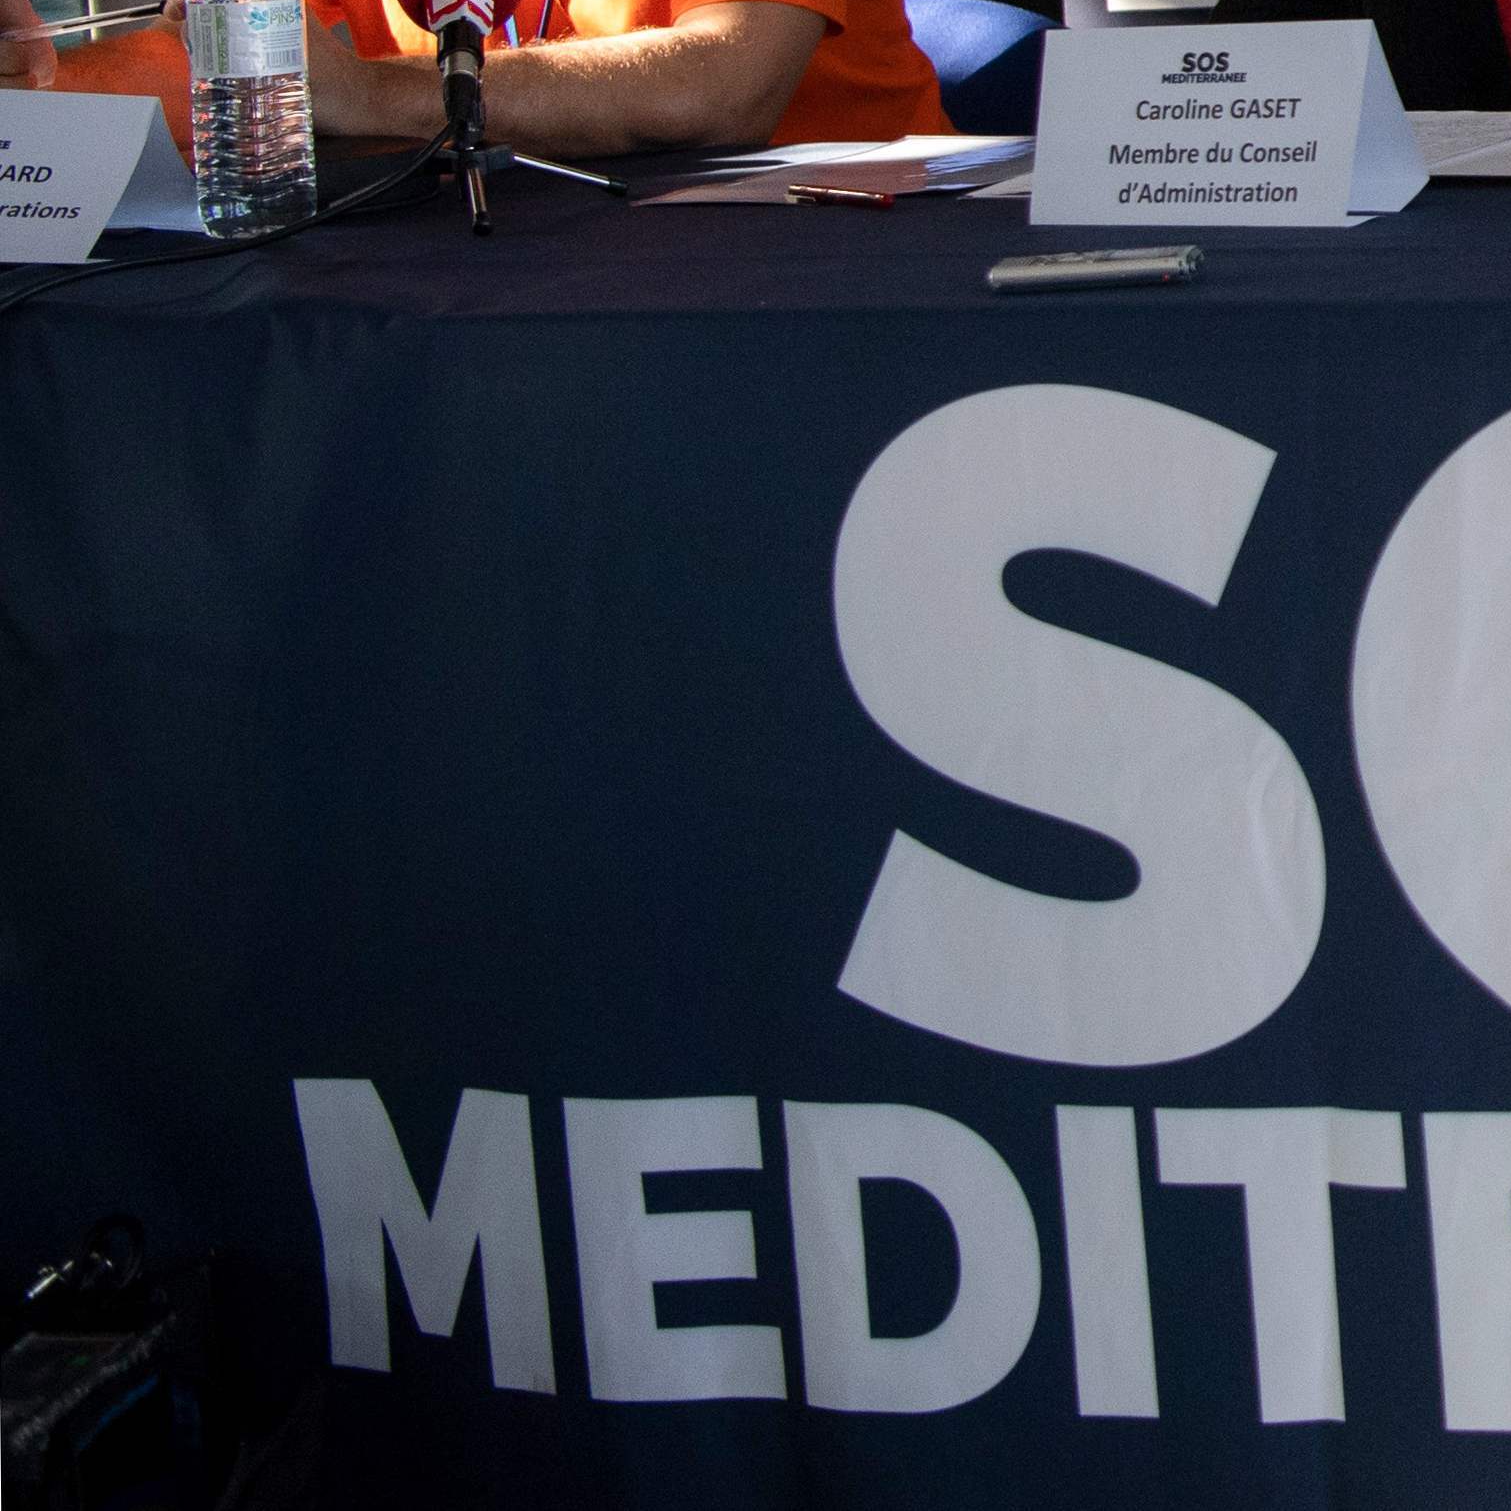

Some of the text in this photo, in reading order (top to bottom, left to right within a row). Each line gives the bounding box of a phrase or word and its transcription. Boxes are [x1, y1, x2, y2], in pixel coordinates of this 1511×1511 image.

[1182, 52, 1230, 73] SOS
[1161, 72, 1248, 85] MEDITERRANEE
[1136, 98, 1301, 121] Caroline GASET
[1109, 141, 1318, 165] Membre du Conseil
[0, 164, 53, 183] ARD
[0, 201, 81, 219] rations
